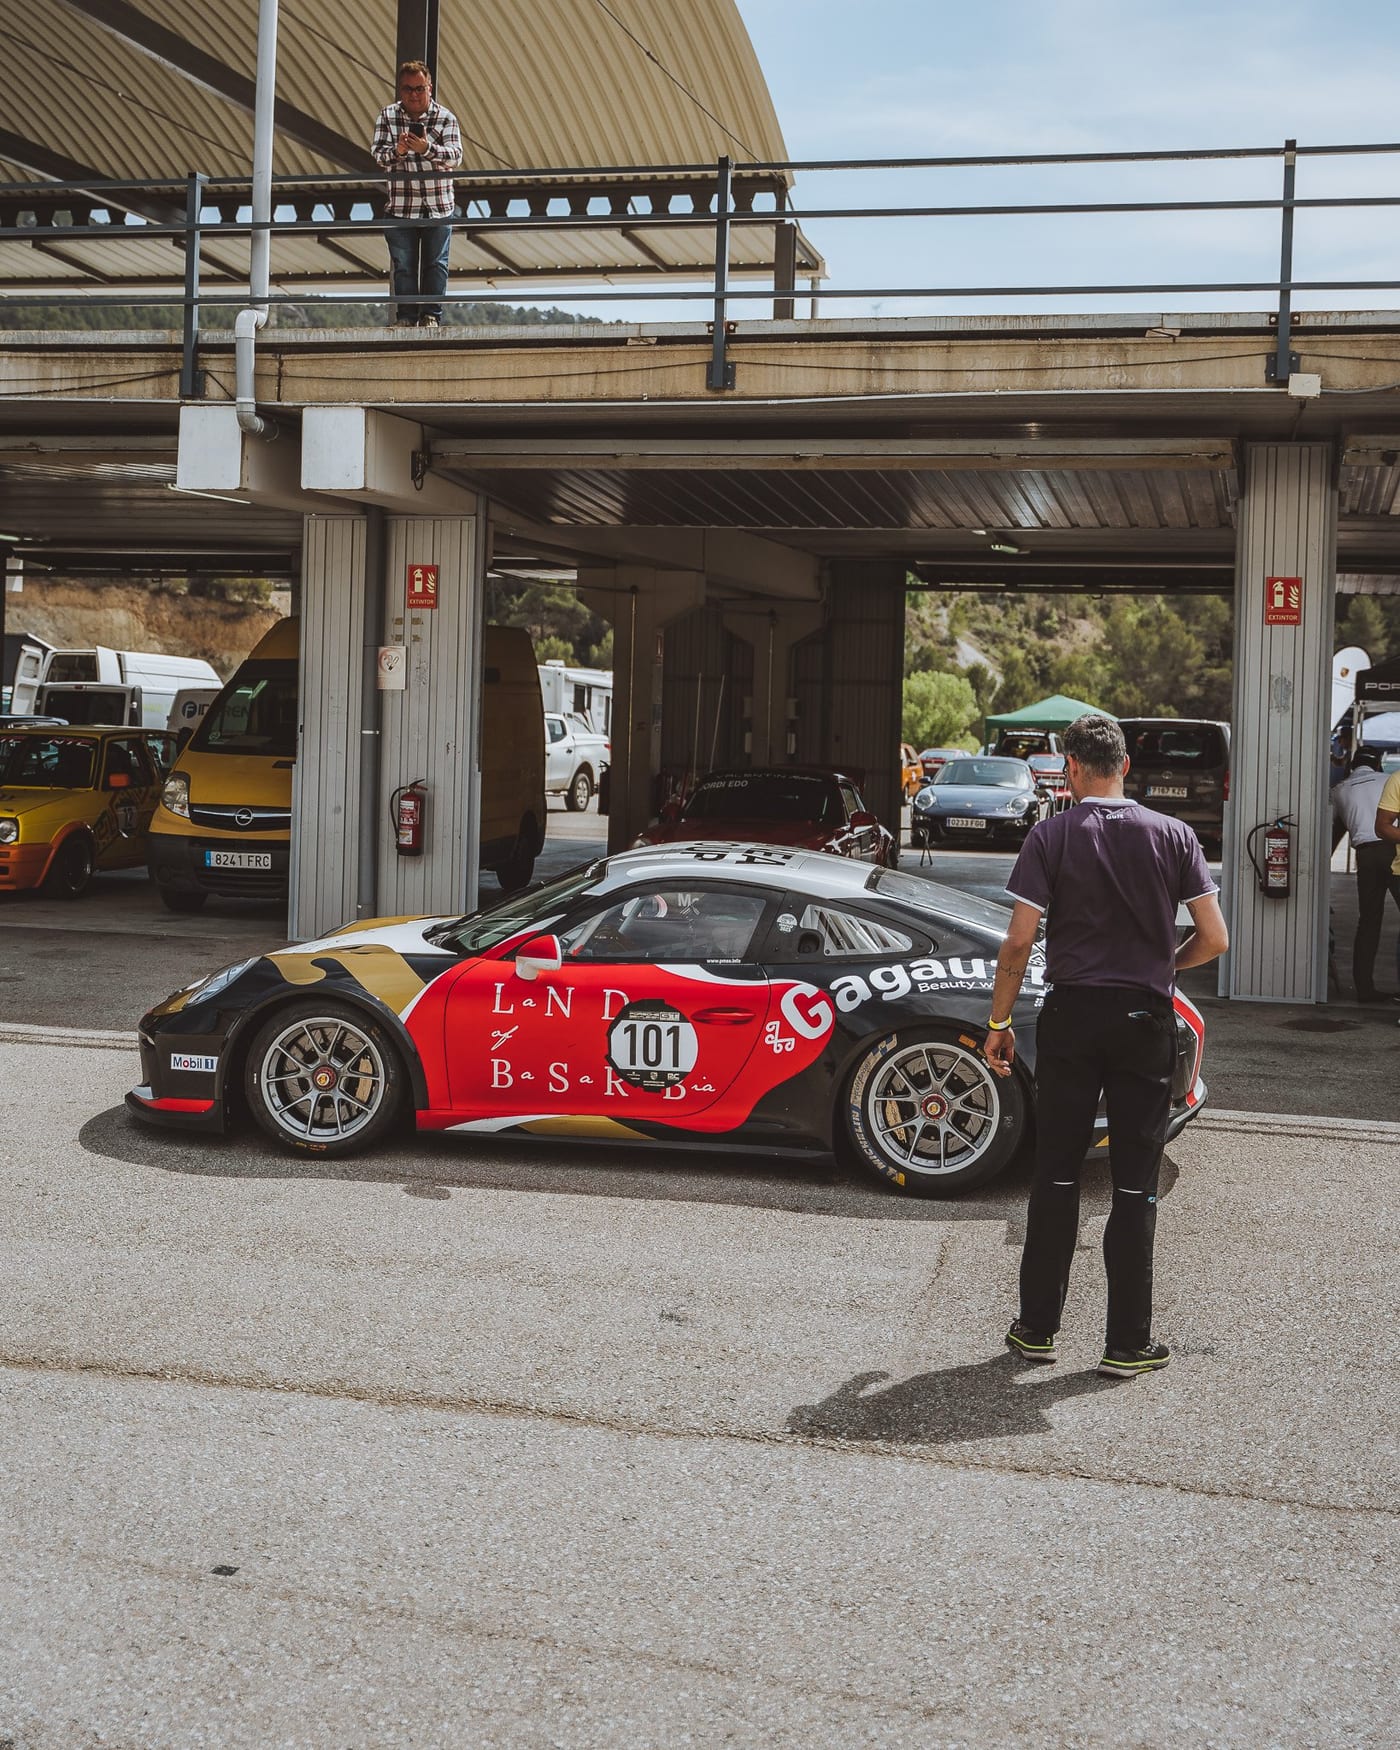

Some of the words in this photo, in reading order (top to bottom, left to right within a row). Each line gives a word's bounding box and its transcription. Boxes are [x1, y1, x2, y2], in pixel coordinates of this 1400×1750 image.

[1268, 614, 1298, 622] EXTINTOR
[951, 818, 969, 827] 0233
[215, 853, 242, 868] 8241
[247, 855, 270, 868] FRC
[917, 979, 975, 993] Beauty
[491, 1025, 519, 1051] of
[623, 1023, 680, 1068] 101
[173, 1056, 202, 1069] Mobil
